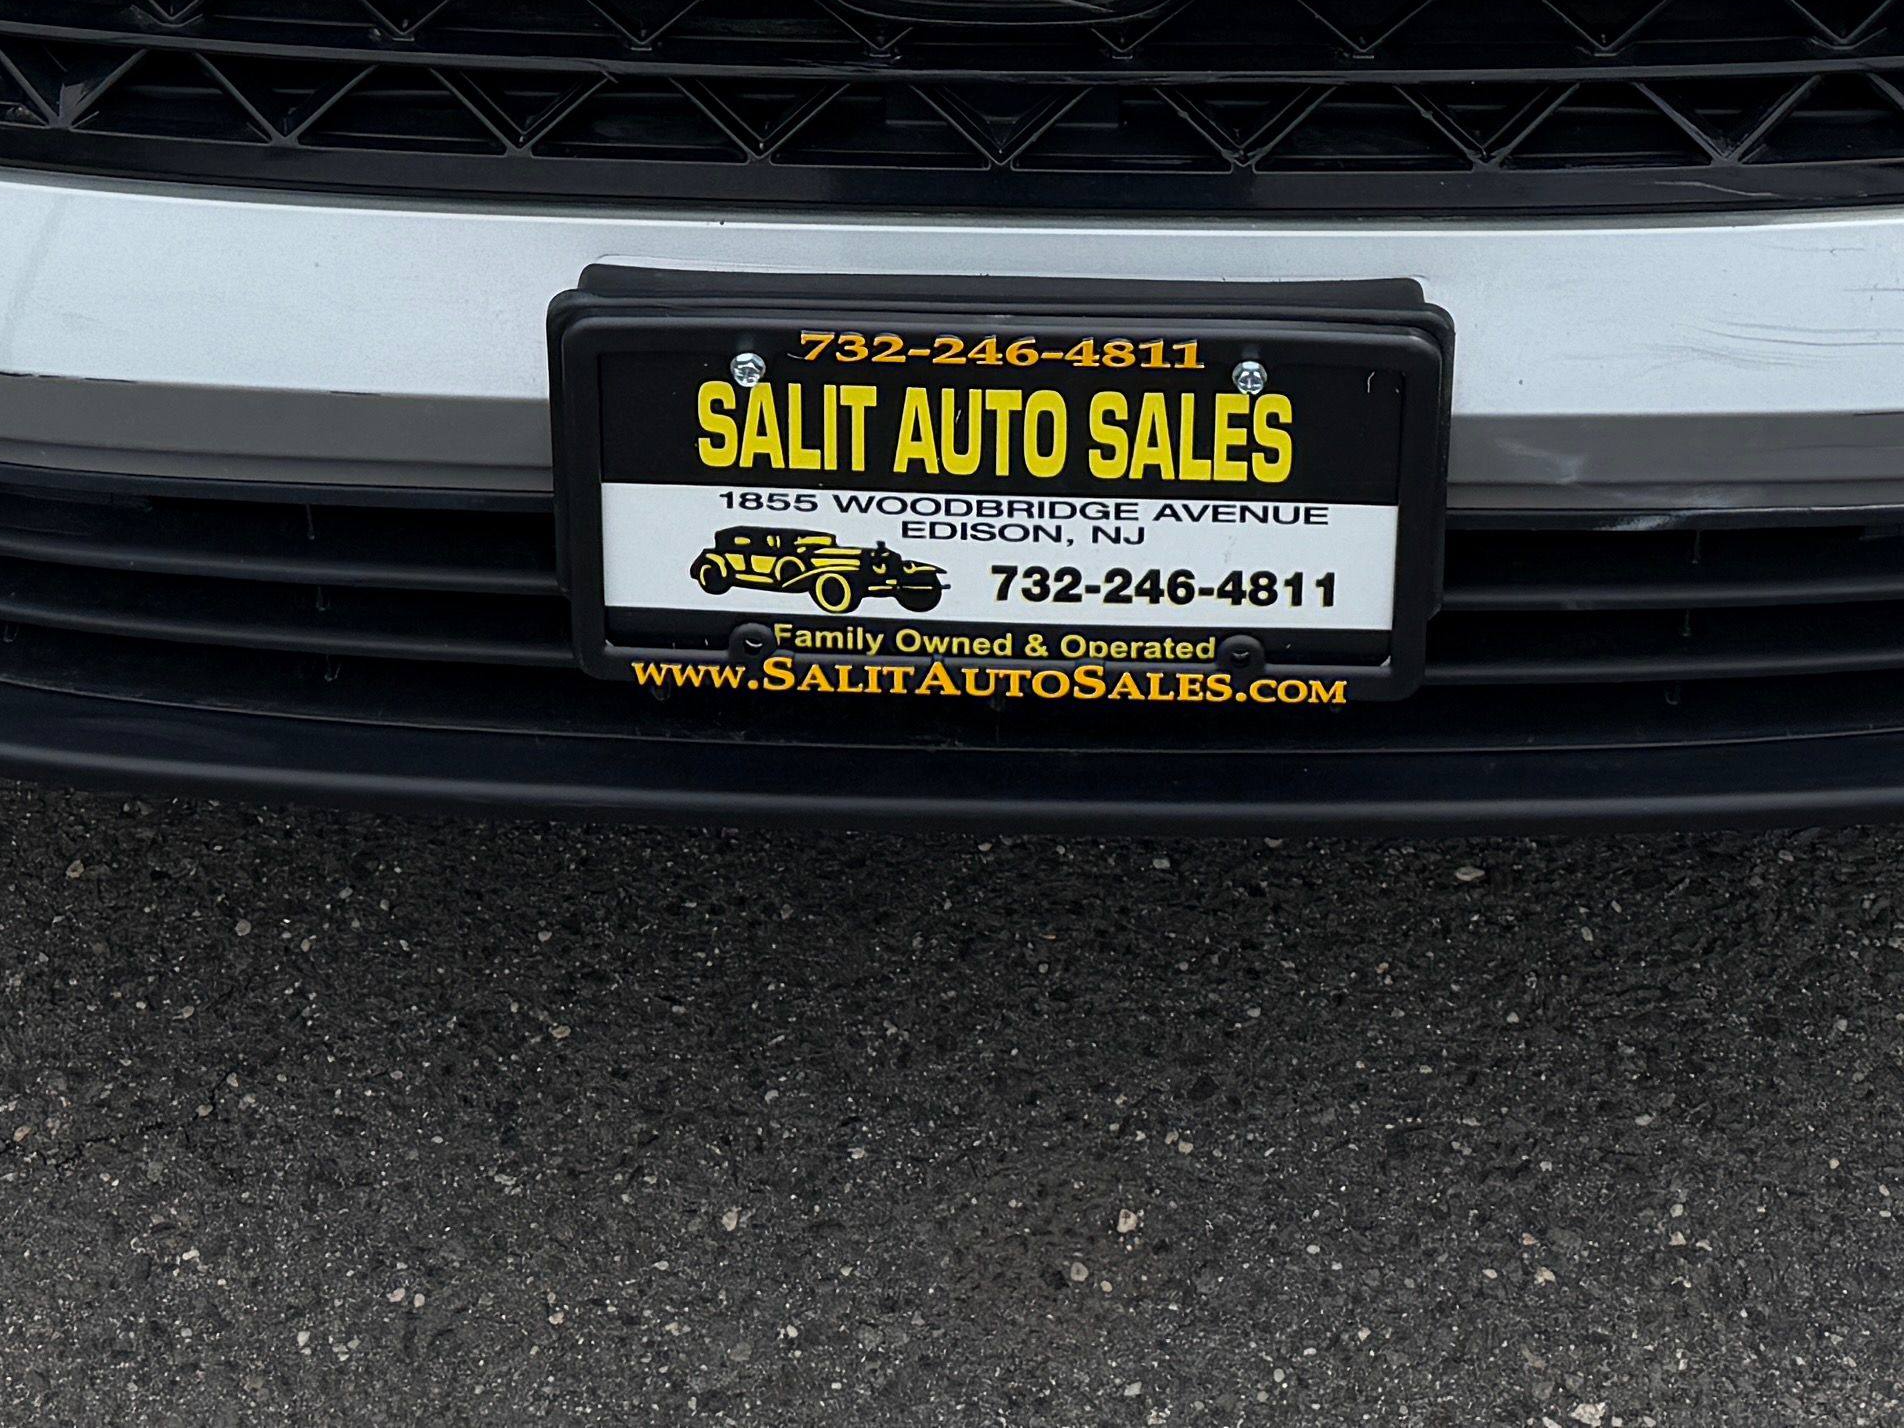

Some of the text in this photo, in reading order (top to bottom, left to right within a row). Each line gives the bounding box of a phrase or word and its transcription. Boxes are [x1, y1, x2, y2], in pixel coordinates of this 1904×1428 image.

[800, 330, 1205, 369] 732-246-4811
[698, 380, 1293, 483] SALIT AUTO SALES
[719, 491, 1329, 525] 1855 WOODBRIDGE AVENUE
[901, 521, 1145, 547] EDISON, NJ
[991, 565, 1336, 608] 732-246-4811
[774, 624, 1216, 660] Family Owned & Operated
